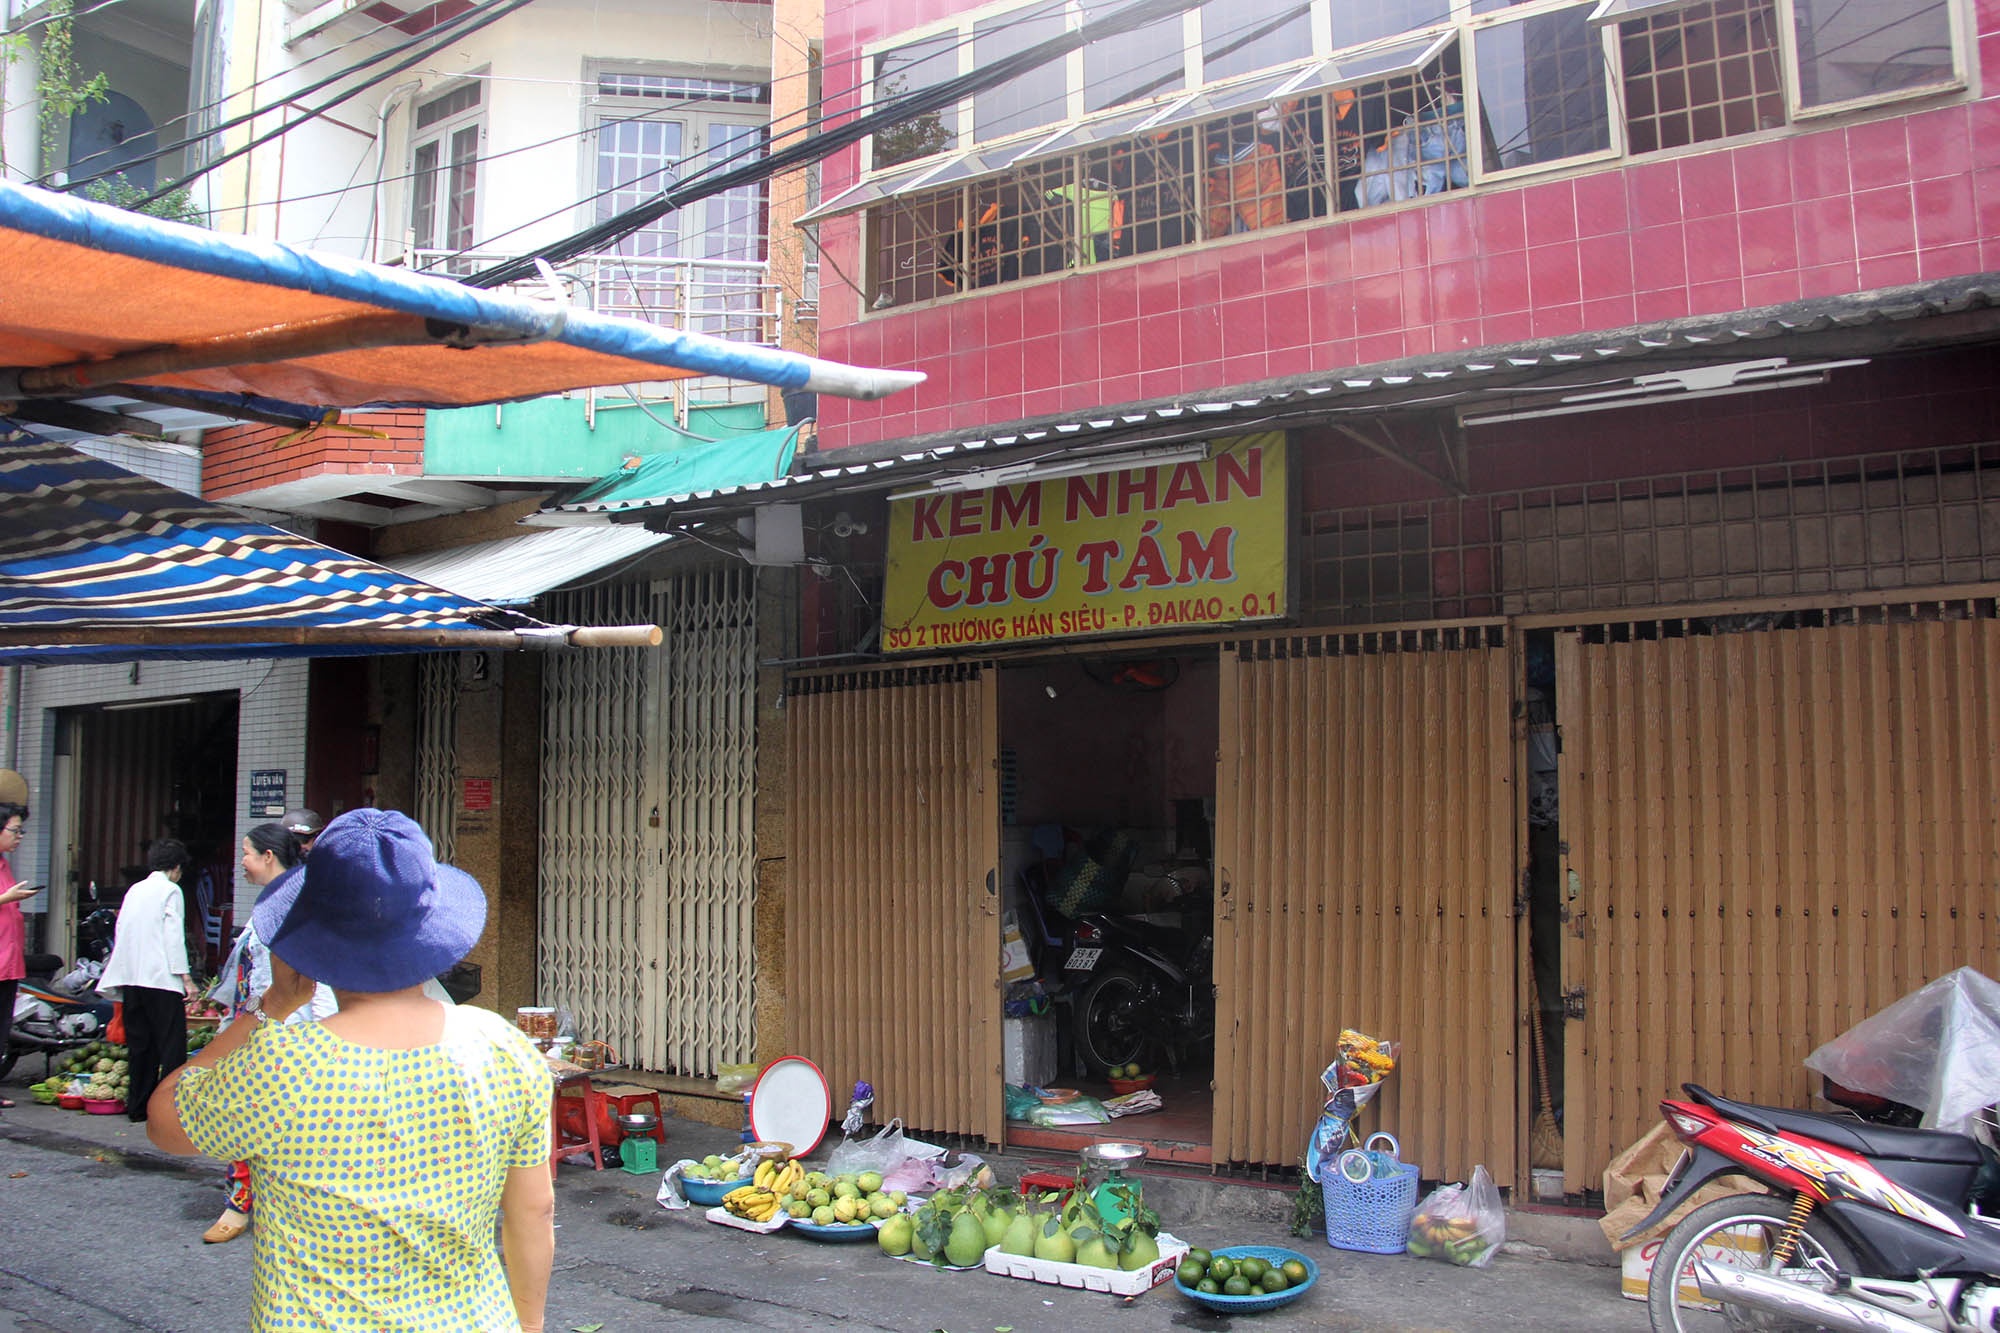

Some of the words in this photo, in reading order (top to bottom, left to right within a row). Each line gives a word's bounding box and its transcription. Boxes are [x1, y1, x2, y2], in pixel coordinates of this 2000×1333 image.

[912, 480, 1043, 543] KEM
[927, 533, 1062, 610] CHÚ
[1076, 519, 1235, 593] TÁM
[889, 620, 912, 648] SỐ
[916, 625, 926, 646] 2
[1012, 608, 1053, 637] HÁN
[1059, 604, 1106, 633] SIÊU
[1124, 605, 1142, 627] P.
[1147, 597, 1223, 625] ĐAKAO
[1242, 592, 1276, 616] Q.1
[473, 653, 485, 680] 2
